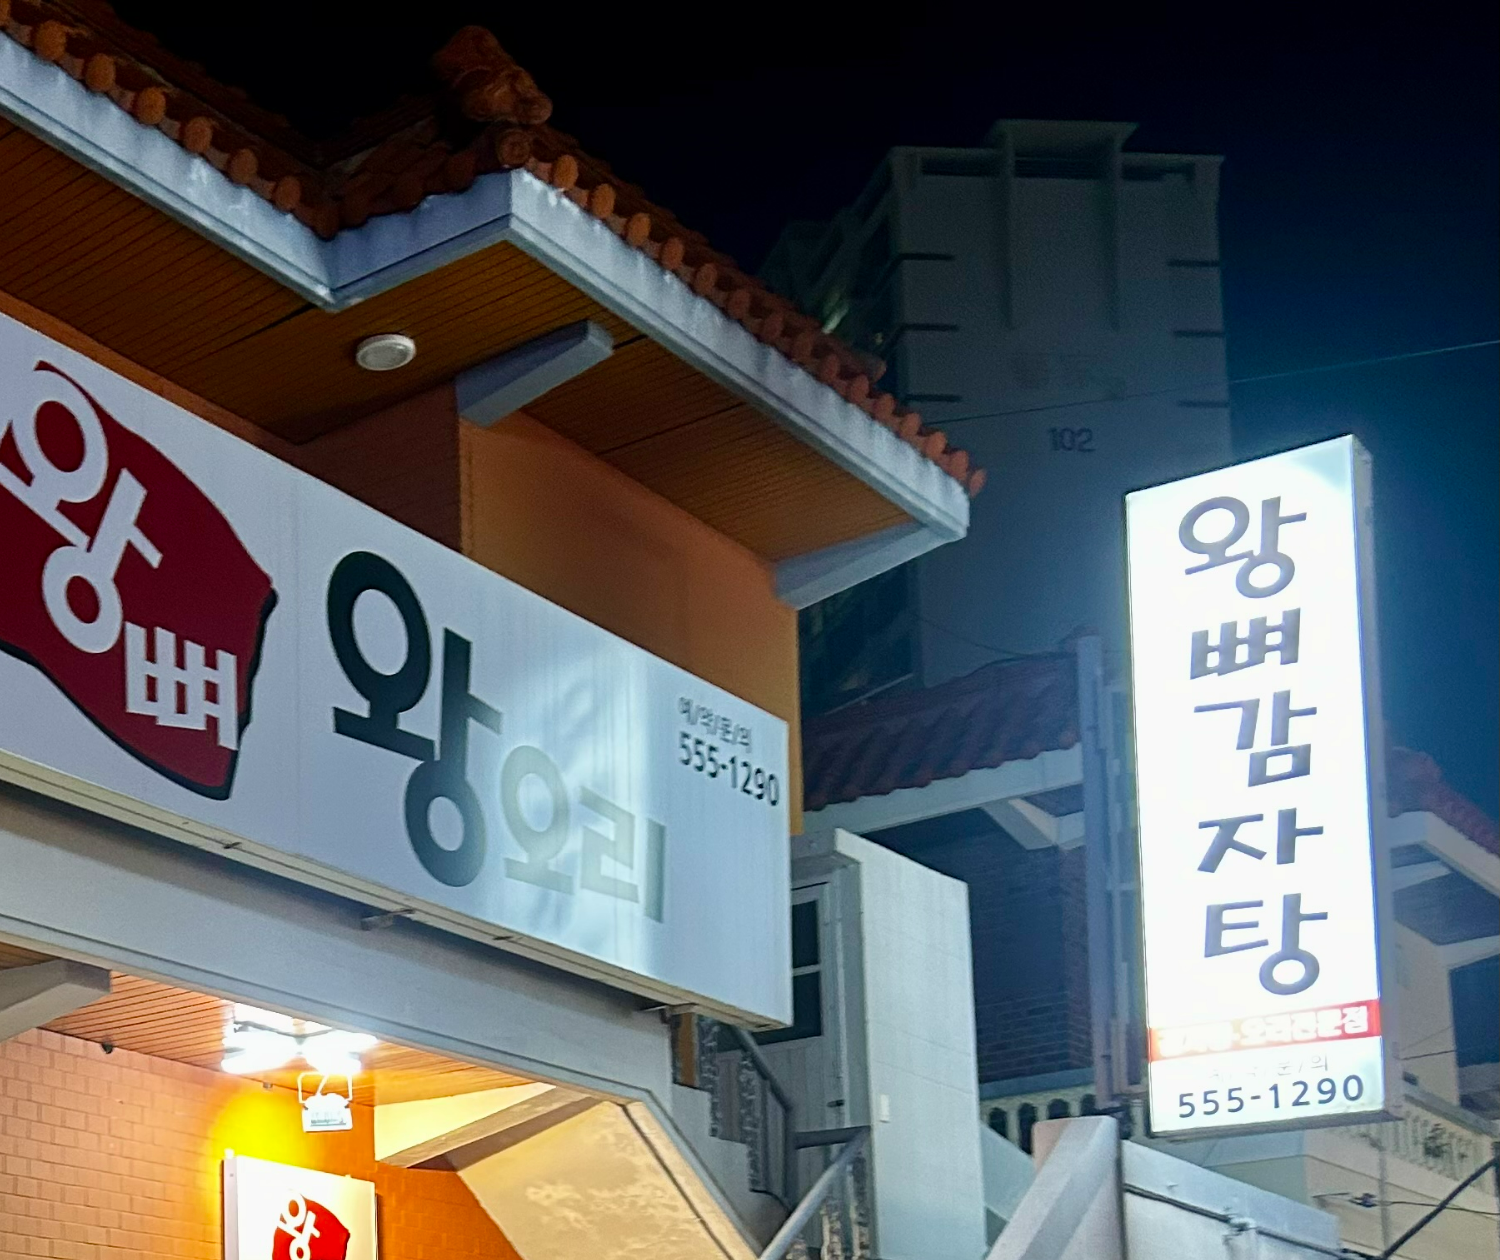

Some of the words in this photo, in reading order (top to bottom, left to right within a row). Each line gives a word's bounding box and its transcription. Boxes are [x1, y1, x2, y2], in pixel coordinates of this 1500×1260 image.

[1049, 427, 1095, 452] 102
[325, 550, 666, 925] 왕오리
[679, 731, 780, 806] 555-1290
[1178, 494, 1329, 997] 왕뼈감자탕
[1178, 1074, 1365, 1118] 555-1290
